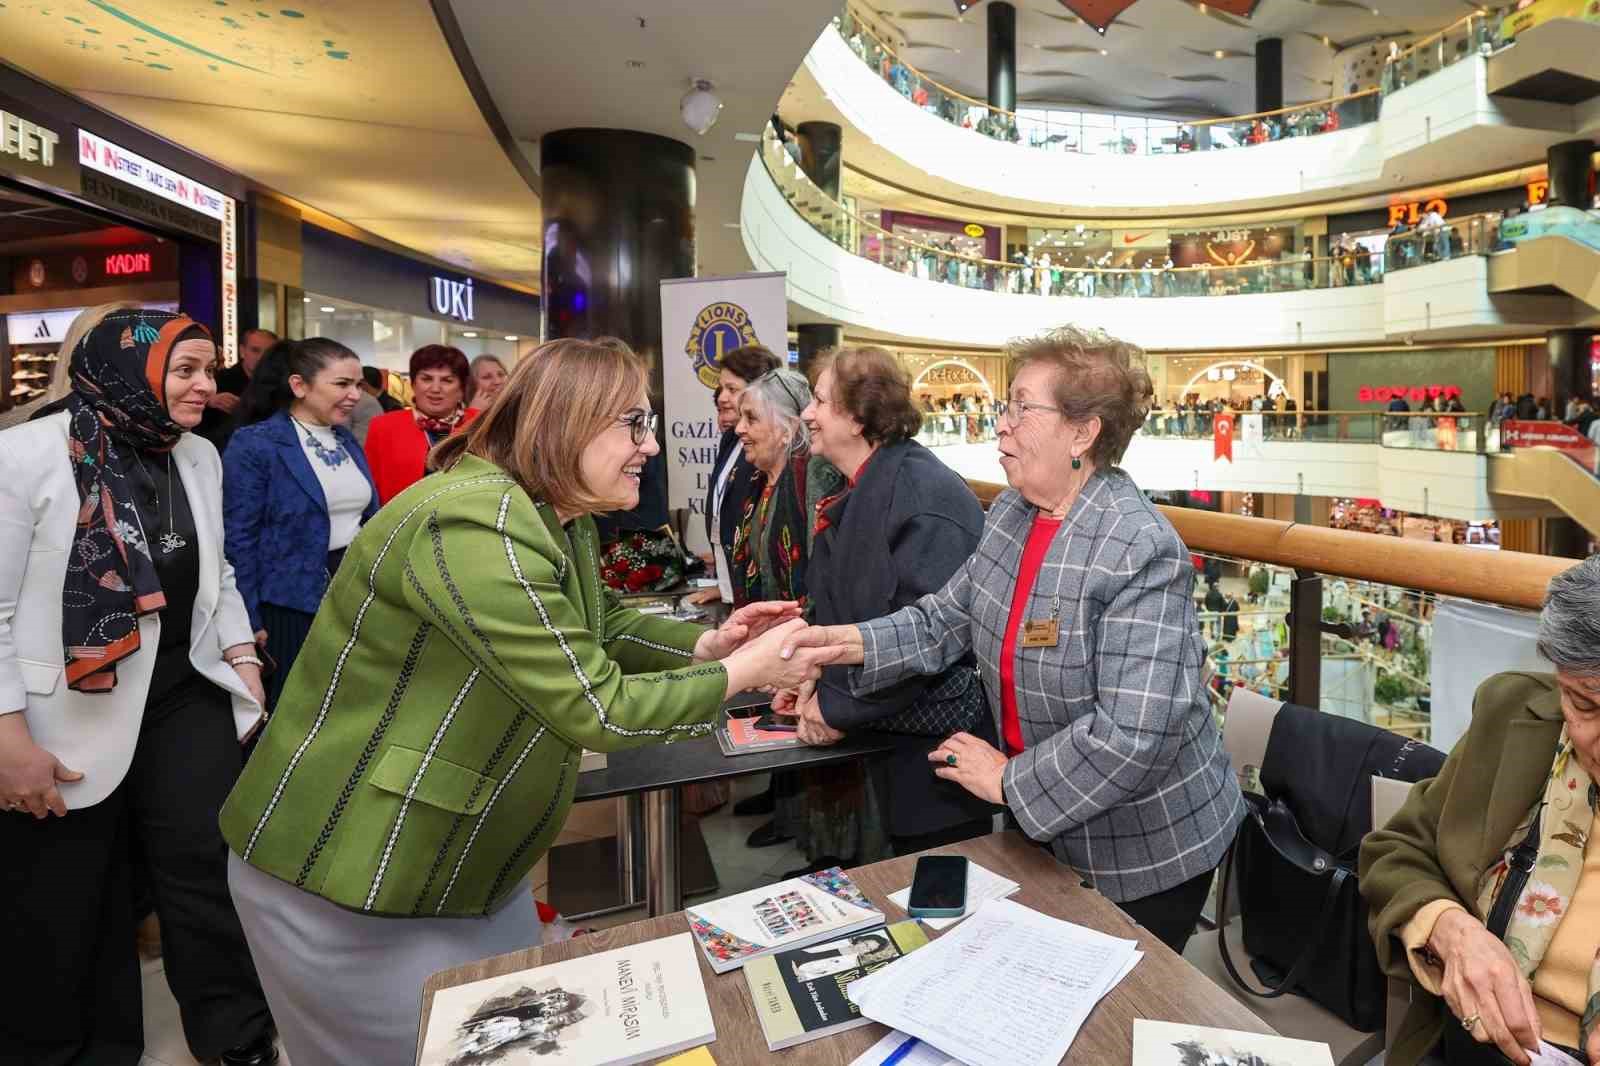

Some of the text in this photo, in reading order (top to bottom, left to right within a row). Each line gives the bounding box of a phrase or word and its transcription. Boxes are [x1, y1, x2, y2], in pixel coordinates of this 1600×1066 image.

[1388, 199, 1448, 227] FLO
[1212, 229, 1251, 243] JUST
[106, 253, 151, 274] KADIN
[432, 277, 474, 322] UKİ
[701, 306, 744, 324] LIONS
[672, 418, 721, 438] GAZİ
